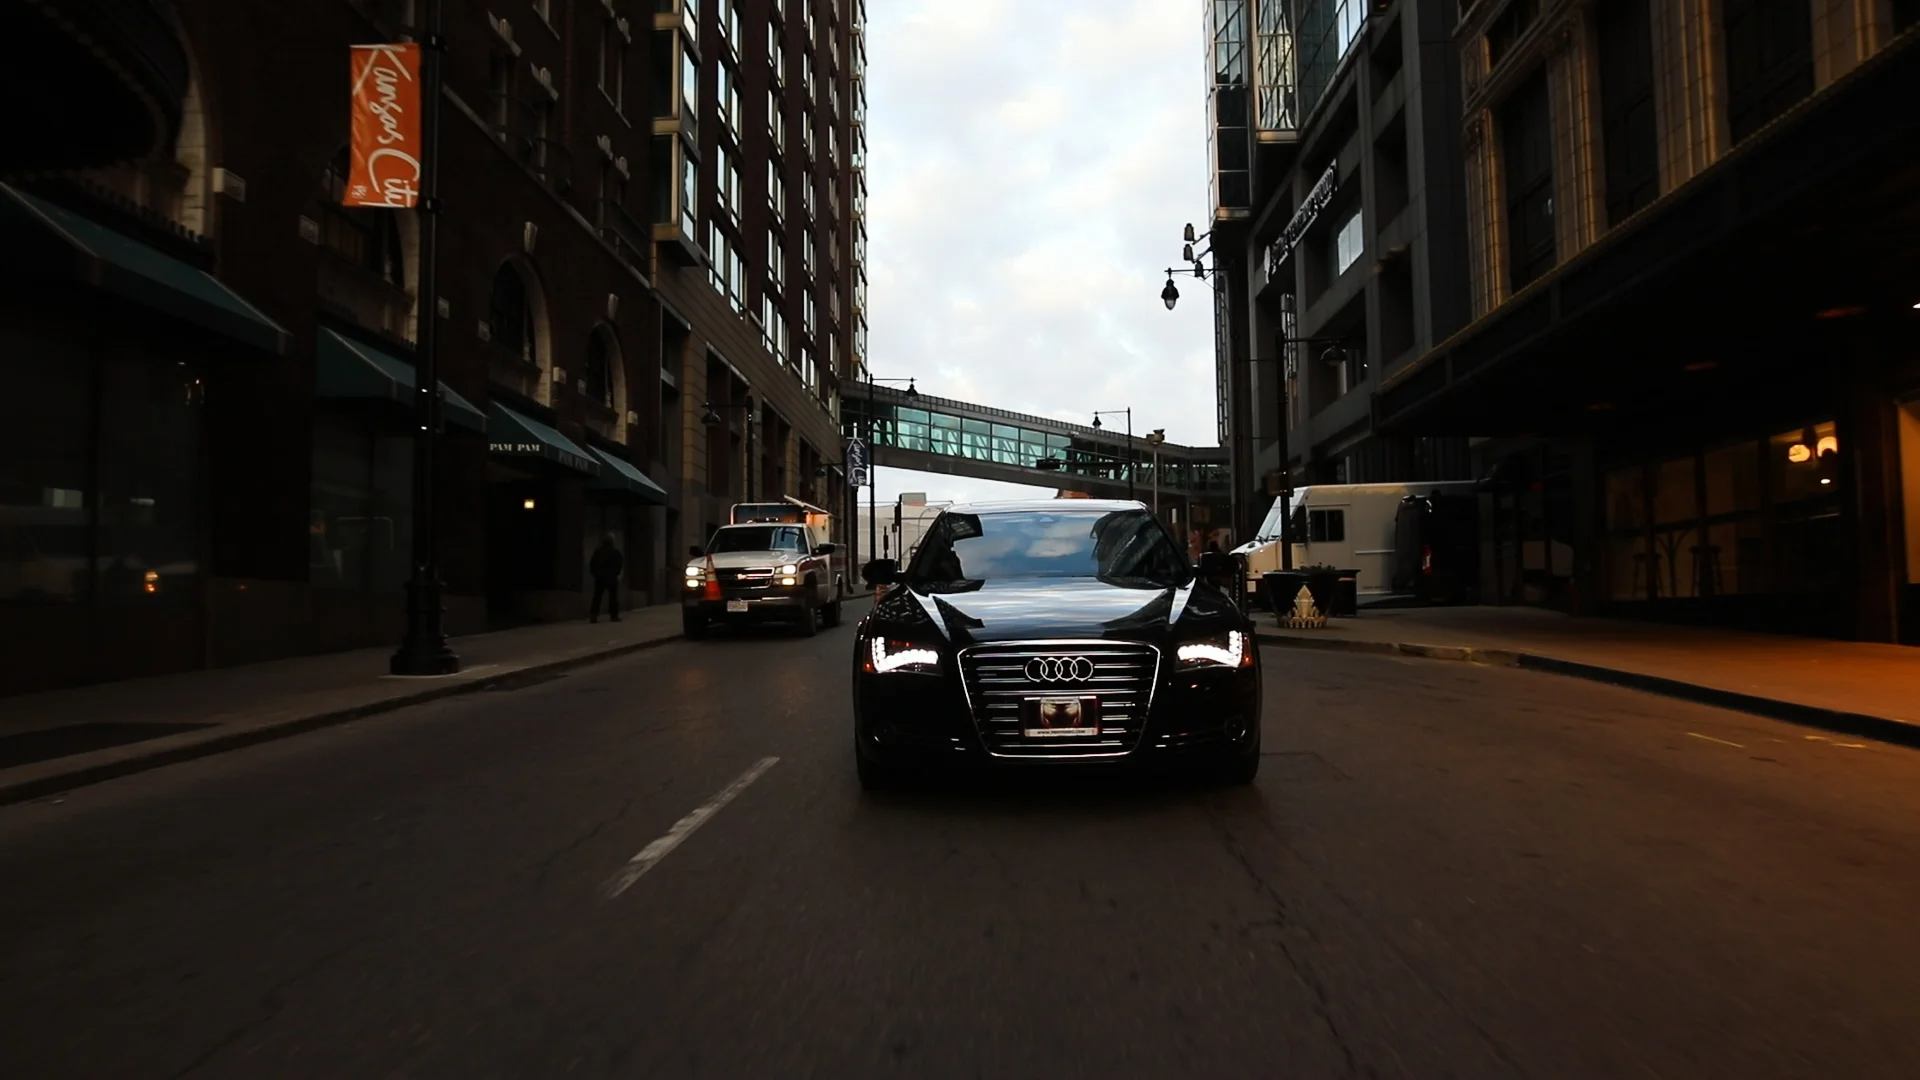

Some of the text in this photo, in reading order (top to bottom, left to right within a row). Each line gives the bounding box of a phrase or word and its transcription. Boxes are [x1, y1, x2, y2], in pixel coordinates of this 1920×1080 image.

[349, 43, 421, 208] Kansas City
[489, 443, 540, 452] PAM PAM
